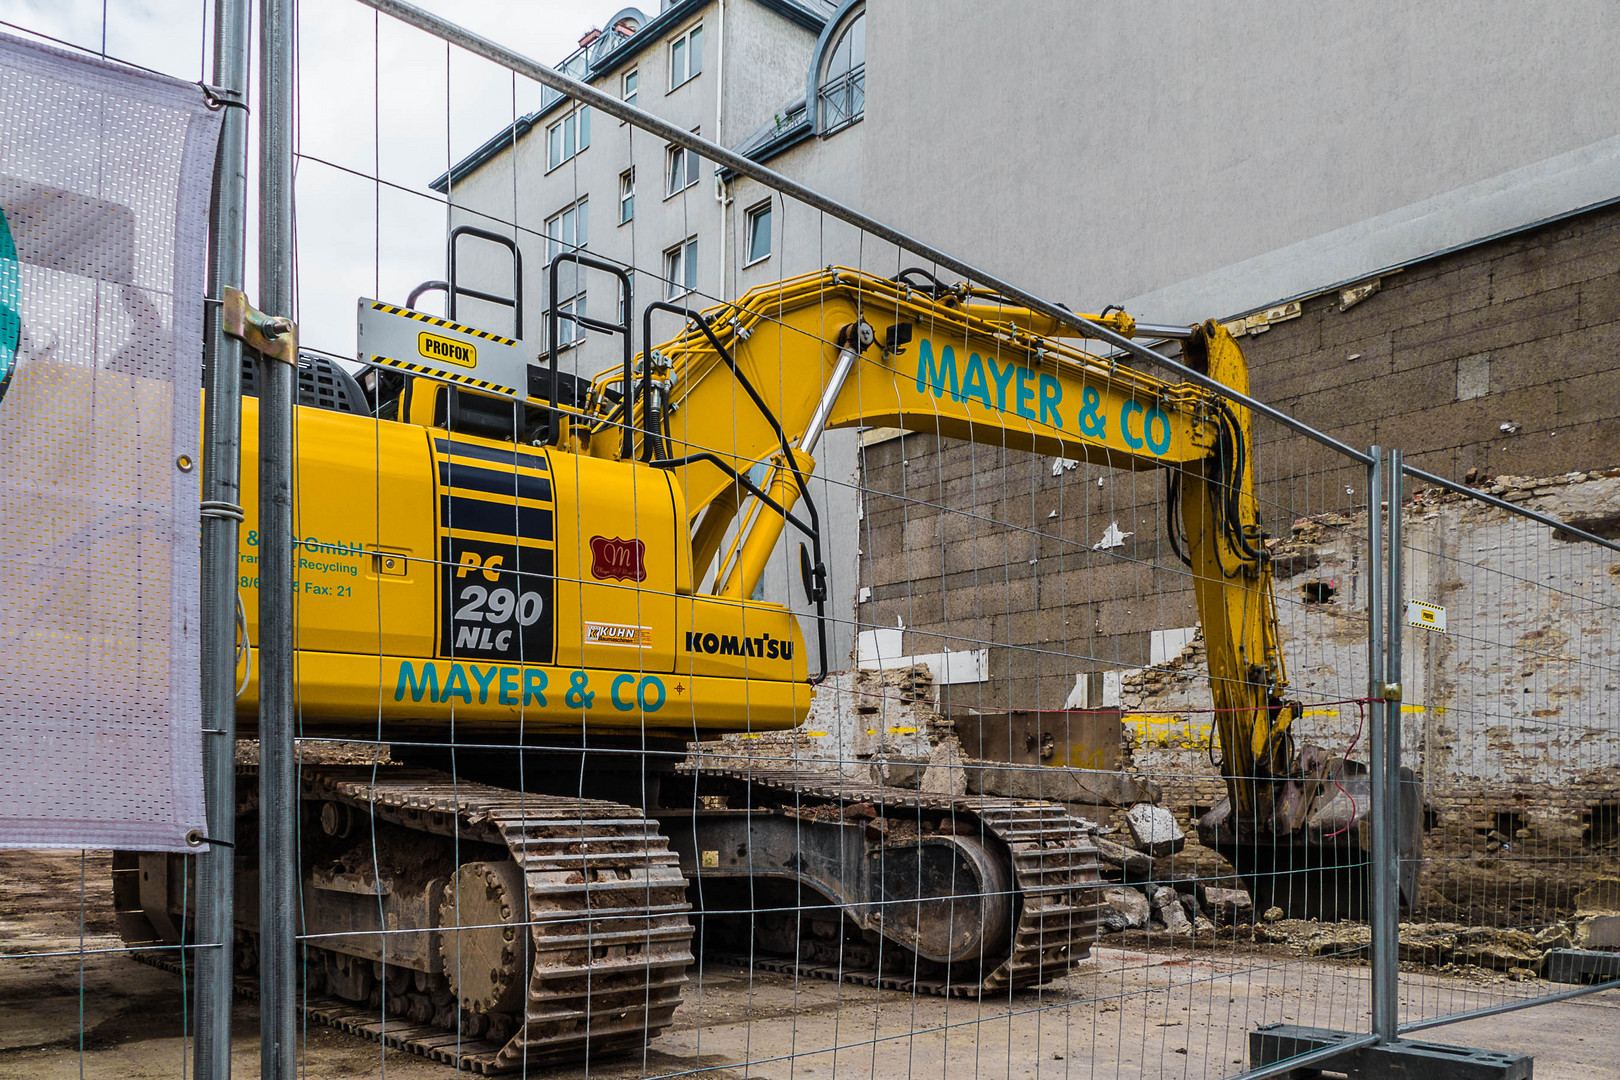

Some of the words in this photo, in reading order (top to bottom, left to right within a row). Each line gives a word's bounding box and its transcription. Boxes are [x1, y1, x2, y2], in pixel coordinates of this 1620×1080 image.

[425, 338, 470, 362] PROFOX
[916, 338, 1063, 428] MAYER
[1077, 385, 1106, 440] &
[1120, 399, 1171, 456] CO
[304, 536, 364, 558] GmbH
[299, 558, 358, 577] Recycling
[456, 551, 504, 582] PC
[304, 582, 333, 596] Fax:
[336, 585, 352, 598] 21
[454, 585, 543, 627] 290
[455, 626, 513, 652] NLC
[600, 626, 636, 639] KUHN
[685, 631, 794, 661] KOMATSU
[394, 660, 549, 708] MAYER
[565, 670, 596, 710] &
[610, 673, 667, 713] CO
